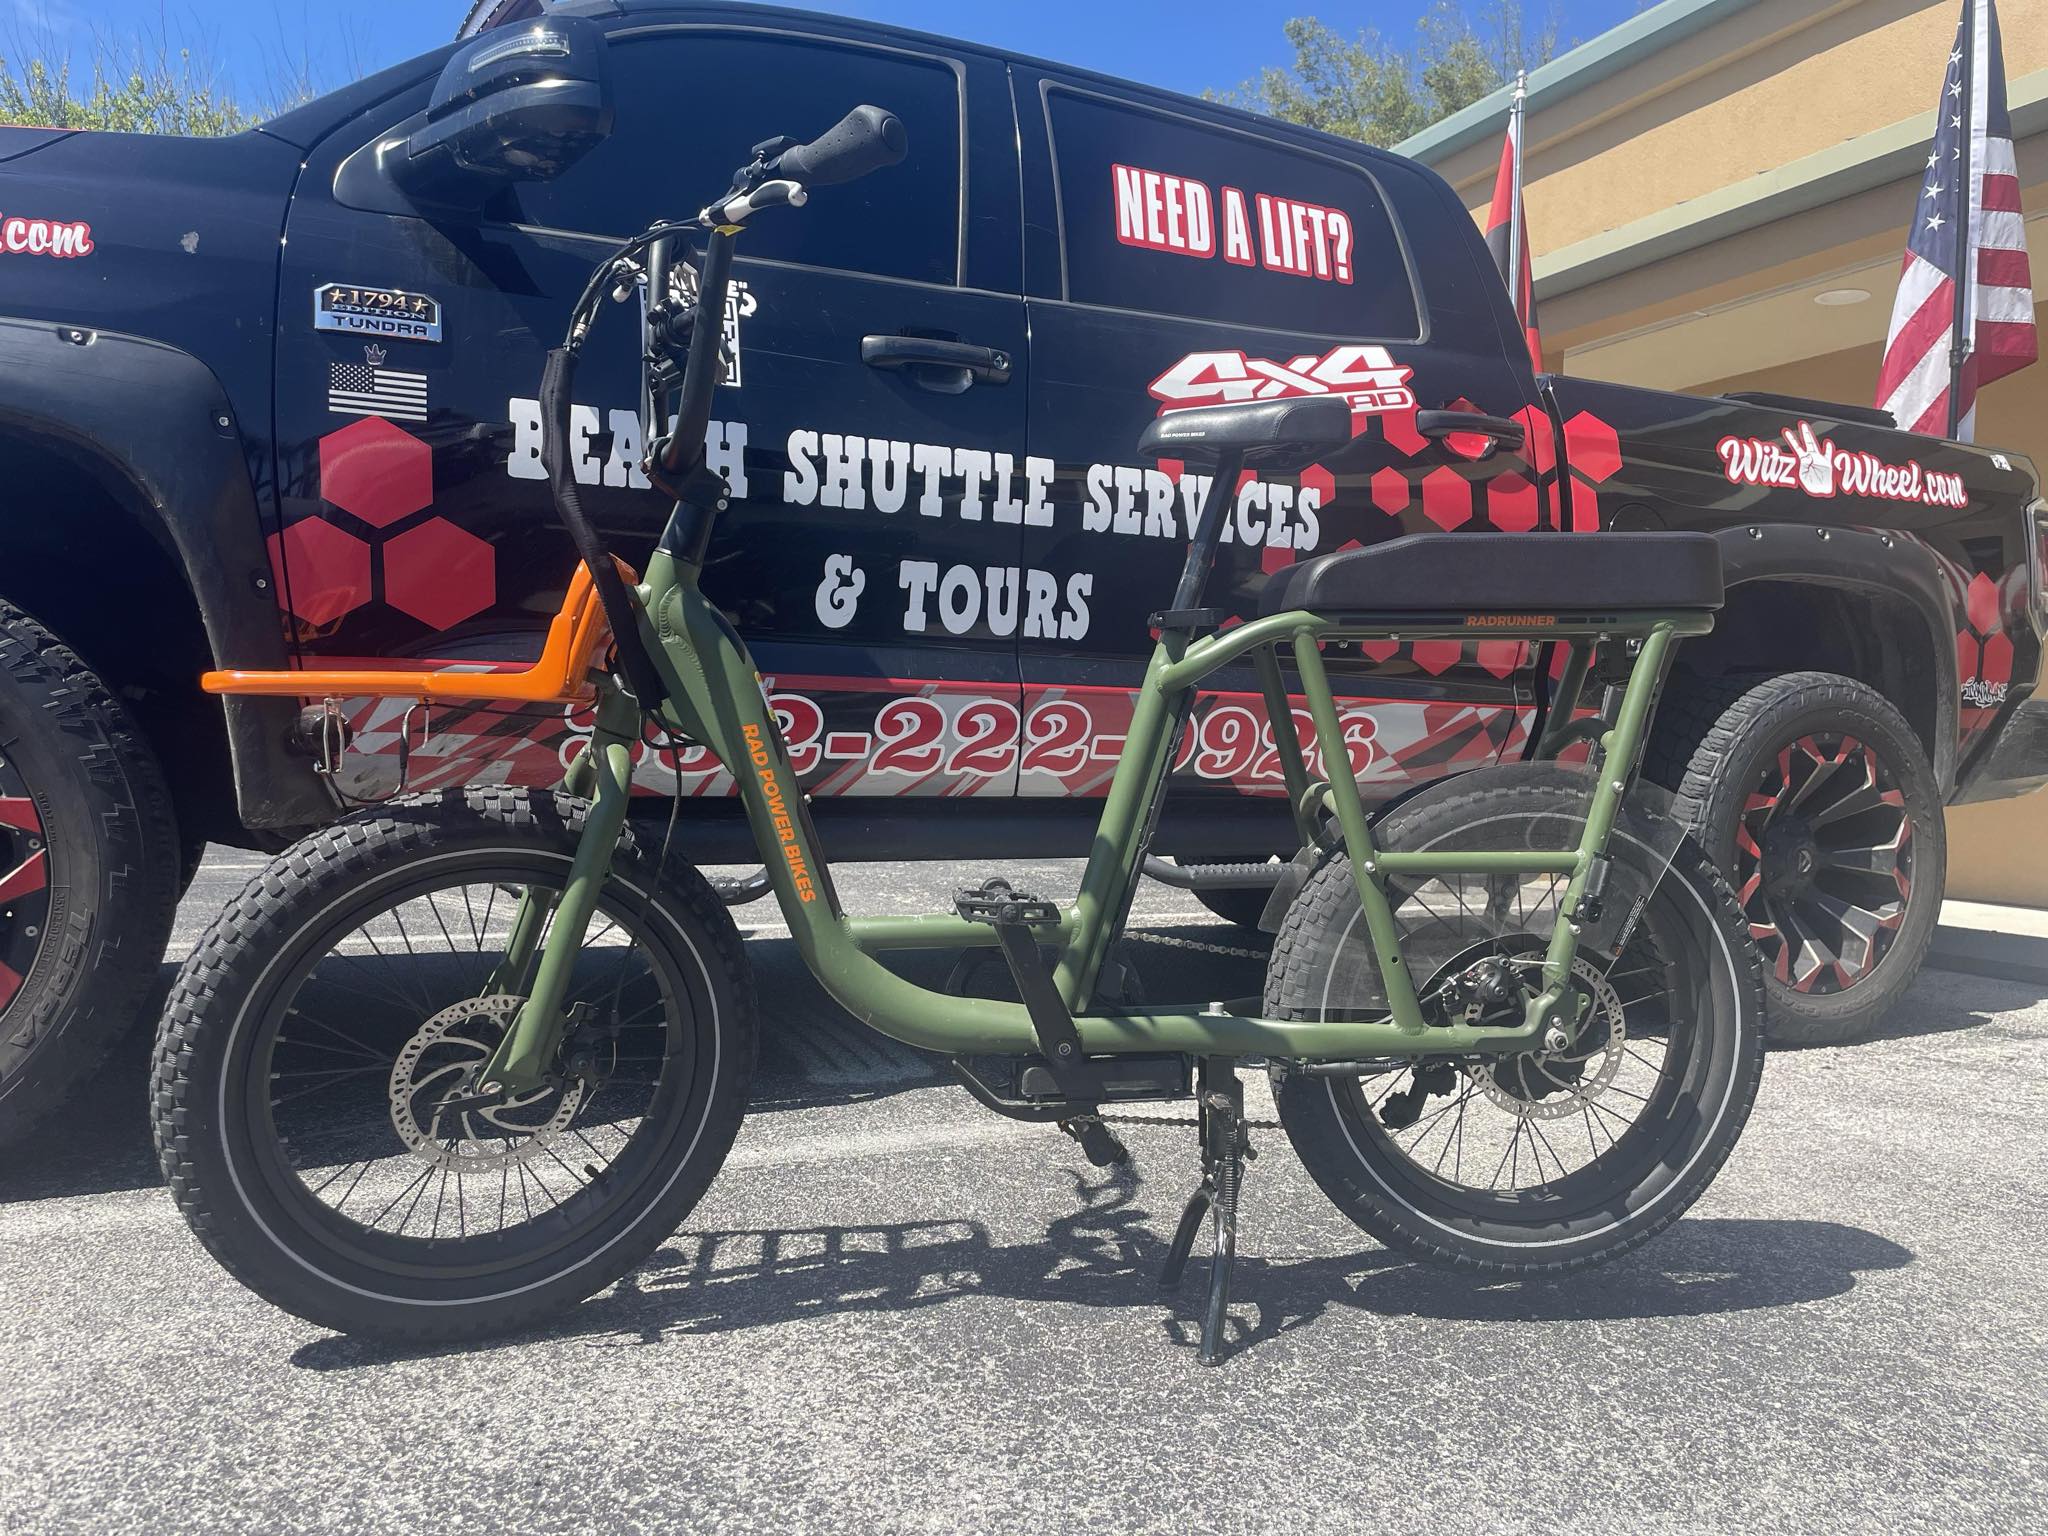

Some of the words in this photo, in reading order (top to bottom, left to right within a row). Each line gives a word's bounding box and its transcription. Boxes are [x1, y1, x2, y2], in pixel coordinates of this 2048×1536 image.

[0, 220, 90, 255] com
[1116, 166, 1211, 252] NEED
[1225, 190, 1251, 260] A
[1259, 197, 1351, 280] LIFT?
[331, 303, 426, 320] EDITION
[332, 315, 429, 336] TUNDRA
[350, 290, 409, 310] 1794
[508, 397, 748, 499] BEAH
[783, 429, 1055, 527] SHUTTLE
[1083, 464, 1321, 551] SERVCES
[1720, 439, 1797, 485] Witz
[1833, 453, 1967, 506] Wheel.com
[815, 553, 866, 629] &
[899, 560, 1094, 641] TOURS
[1466, 615, 1556, 627] RADRUNNER
[741, 723, 769, 767] RAD
[758, 767, 796, 842] POWER
[784, 844, 817, 904] BIKES
